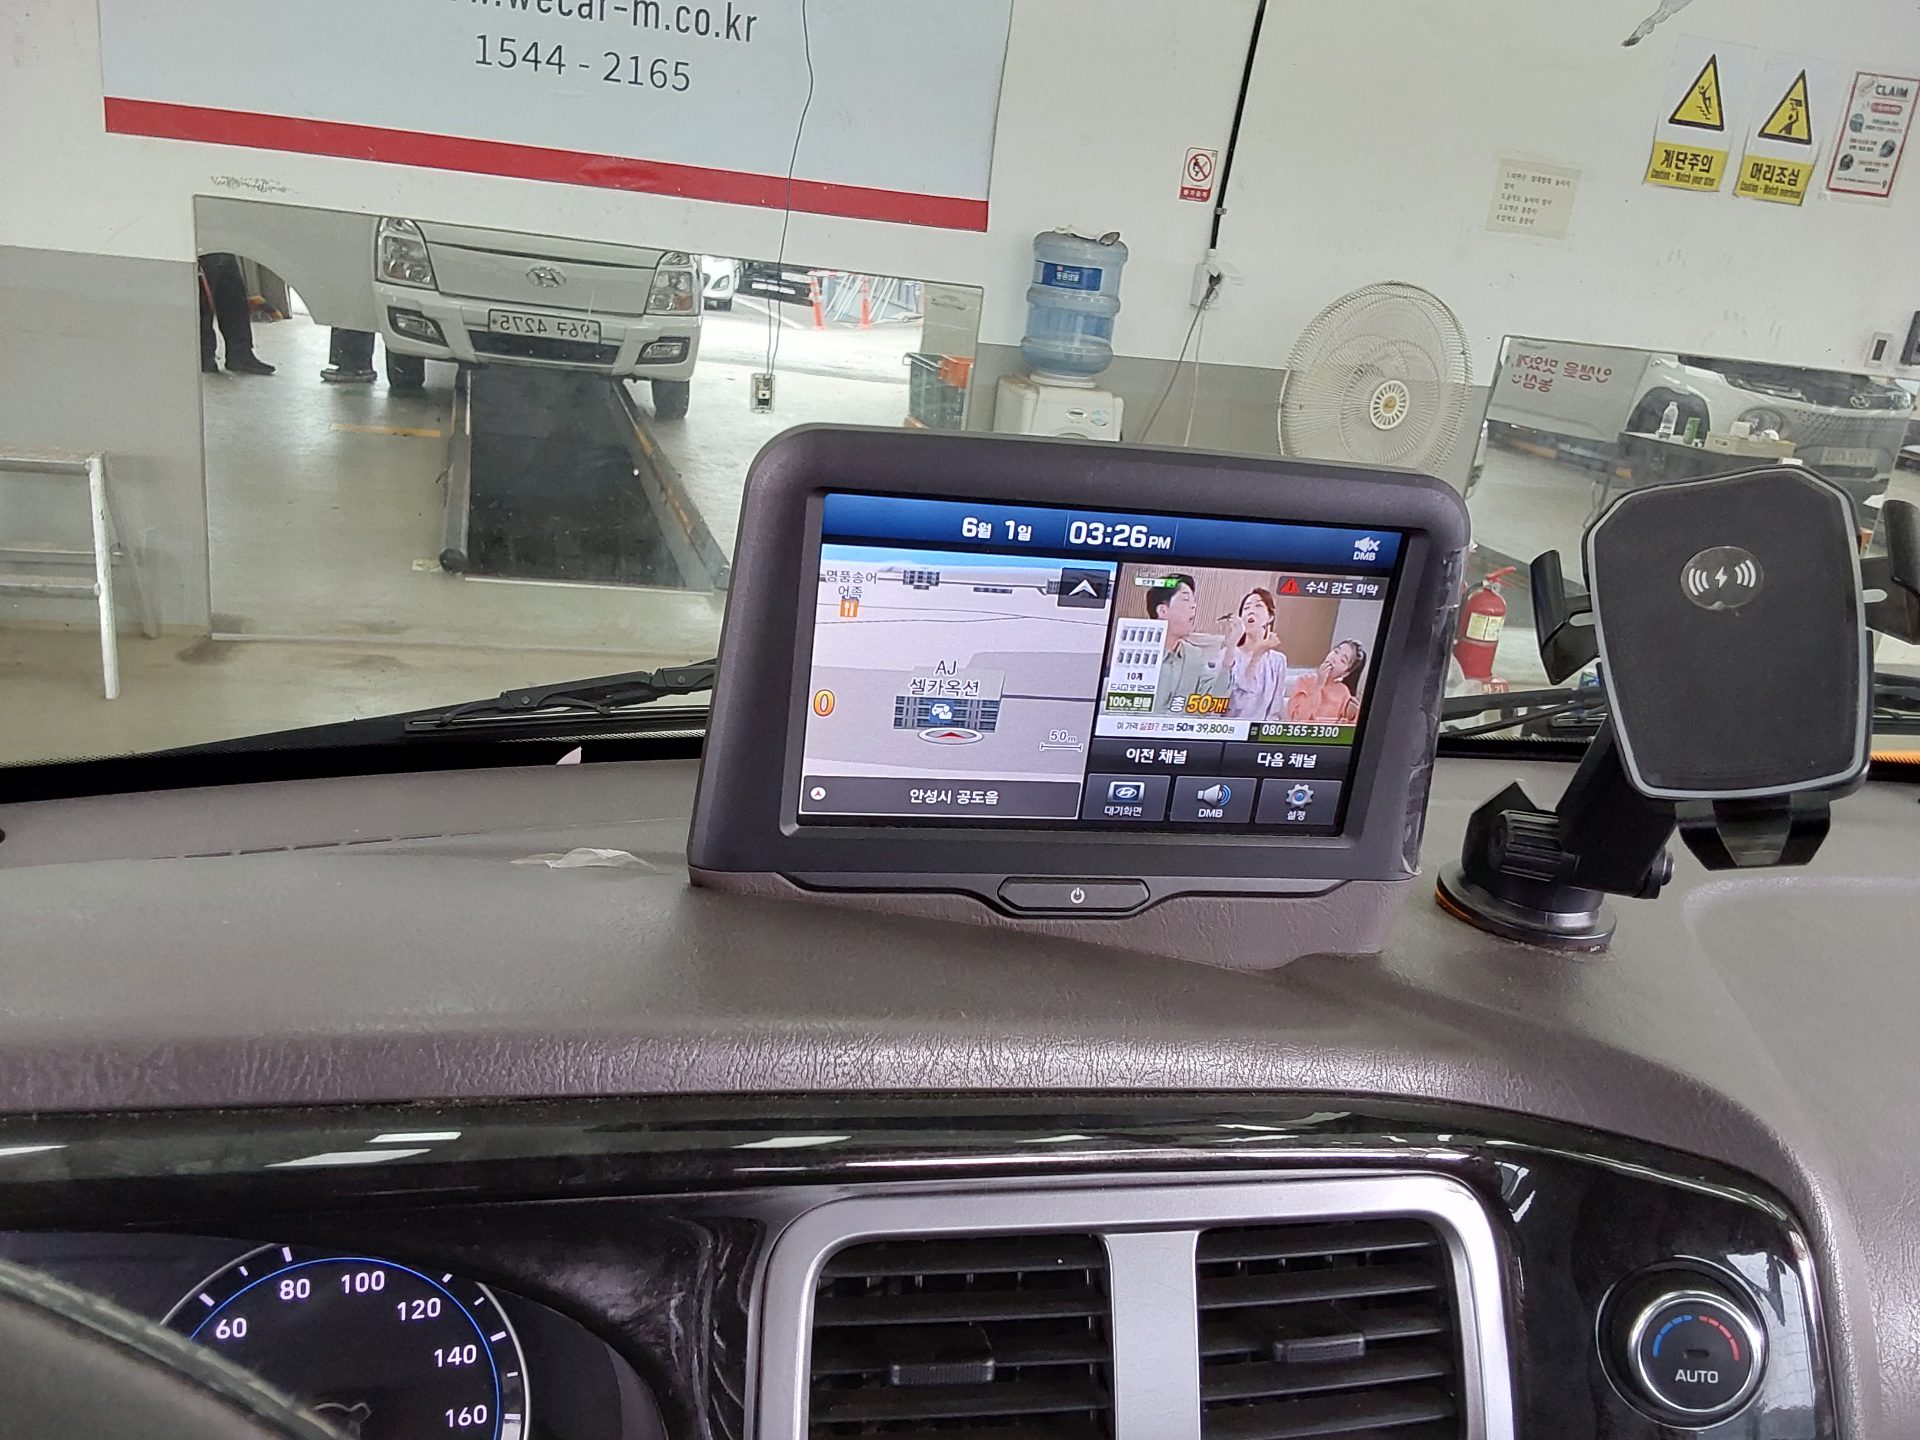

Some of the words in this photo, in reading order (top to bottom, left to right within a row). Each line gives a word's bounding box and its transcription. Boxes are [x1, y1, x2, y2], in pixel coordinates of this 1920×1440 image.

[470, 0, 757, 42] .ecar-m.co.kr
[475, 34, 566, 75] 1544
[602, 51, 690, 92] 2165
[1875, 85, 1909, 99] CLAIM
[1660, 149, 1714, 174] 계단주의
[1750, 162, 1801, 187] 머리조심
[961, 516, 992, 539] 6월
[1004, 519, 1032, 542] 1일
[1353, 551, 1376, 561] DMB
[826, 569, 877, 585] 명품송어
[1305, 581, 1329, 594] 수신
[1331, 582, 1353, 595] 감도
[1356, 583, 1379, 597] 미약
[935, 659, 957, 677] AJ
[1127, 672, 1143, 681] 10개
[908, 678, 980, 697] 셀카옥션
[813, 689, 835, 717] 0
[1108, 696, 1132, 707] 100%
[1169, 695, 1186, 712] 총
[1185, 694, 1229, 714] 50개!
[1176, 722, 1194, 732] 50개
[1261, 724, 1340, 738] 080-365-3300
[1049, 730, 1076, 743] 50m
[1126, 748, 1154, 764] 이전
[1158, 749, 1187, 765] 채널
[1257, 751, 1285, 768] 다음
[1288, 753, 1317, 769] 채널
[909, 788, 952, 805] 안성시
[956, 789, 999, 806] 공도읍
[1103, 805, 1143, 817] 대기화면
[1198, 808, 1223, 819] DMB
[1286, 810, 1307, 821] 설정
[279, 1278, 311, 1300] 80
[340, 1270, 386, 1295] 100
[397, 1297, 442, 1322] 120
[215, 1317, 248, 1340] 60
[434, 1344, 477, 1369] 140
[1674, 1368, 1719, 1384] AUTO
[444, 1404, 488, 1429] 160
